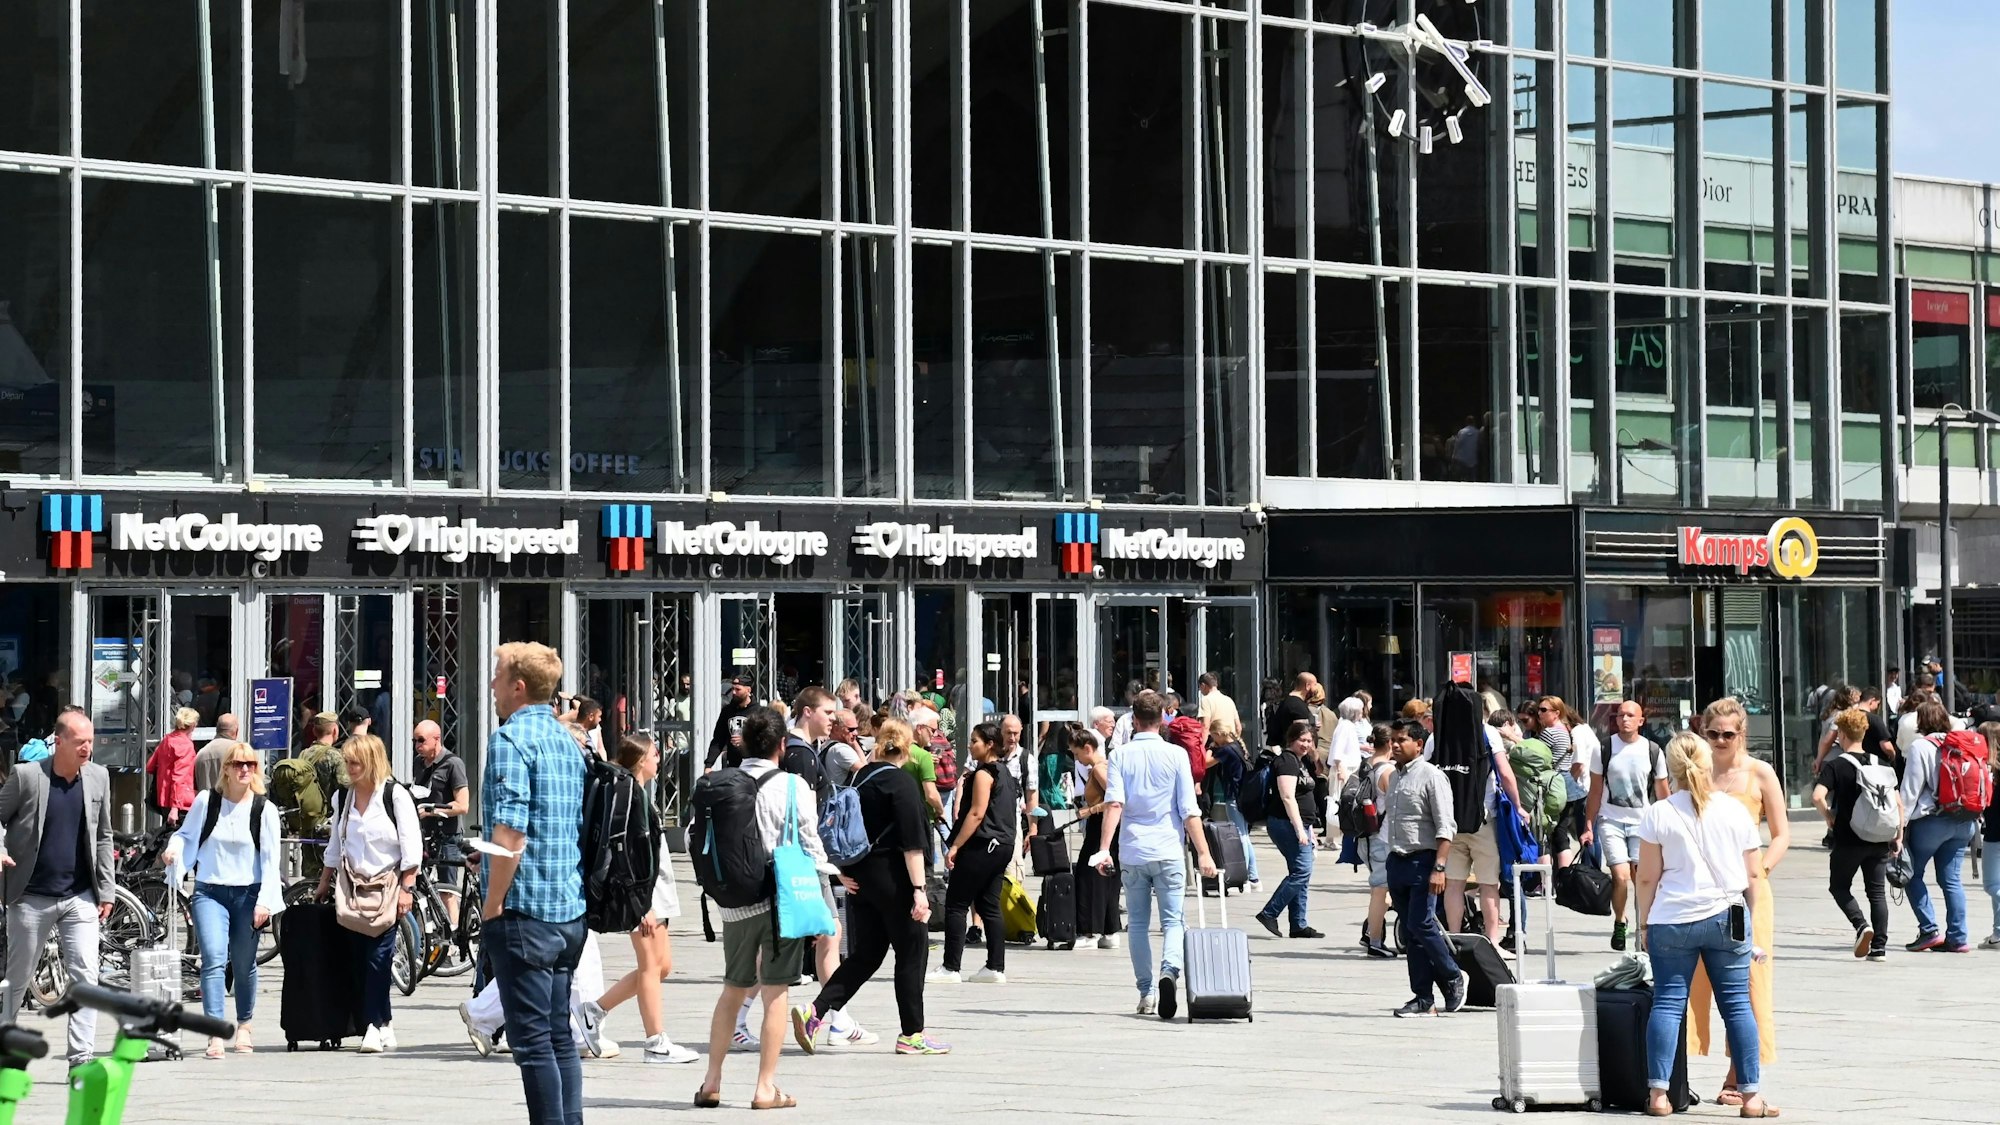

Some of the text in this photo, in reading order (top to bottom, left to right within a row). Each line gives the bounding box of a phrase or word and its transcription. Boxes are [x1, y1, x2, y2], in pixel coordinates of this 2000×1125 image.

[1702, 177, 1732, 202] ior
[420, 447, 639, 475] STAUCKS OFFEE
[111, 512, 322, 561] NetCologne
[409, 515, 577, 562] Highspeed
[657, 520, 828, 564] NetCologne
[900, 523, 1036, 566] Highspeed
[1101, 527, 1243, 568] NetCologne
[1678, 526, 1769, 575] Kamps
